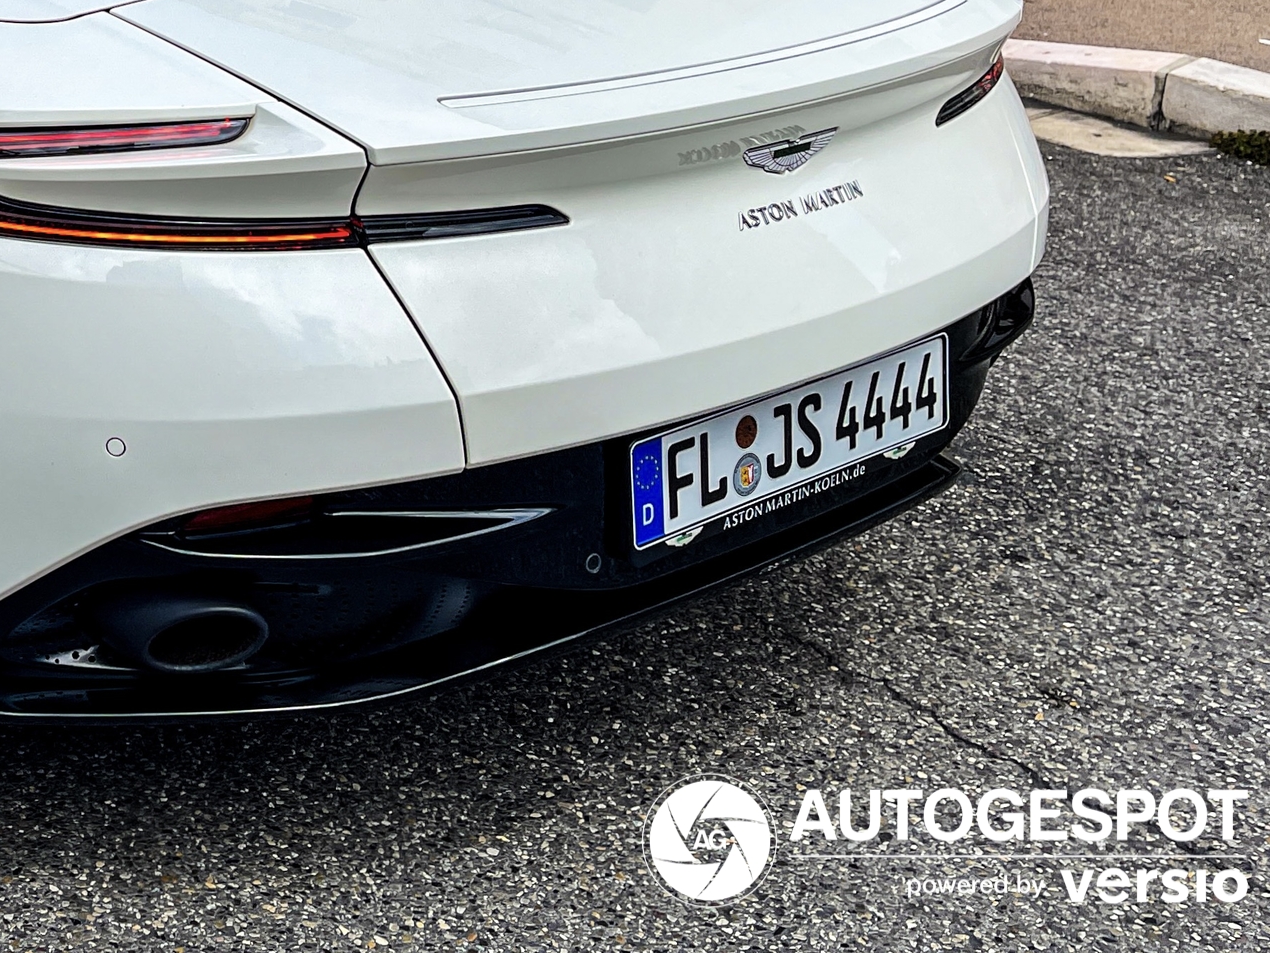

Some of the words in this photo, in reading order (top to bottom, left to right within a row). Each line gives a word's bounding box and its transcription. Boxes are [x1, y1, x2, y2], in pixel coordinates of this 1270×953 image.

[738, 199, 798, 231] ASTON
[799, 179, 864, 216] MARTIN
[666, 432, 728, 520] FL
[766, 392, 823, 479] JS
[835, 352, 937, 450] 4444
[642, 503, 654, 526] D
